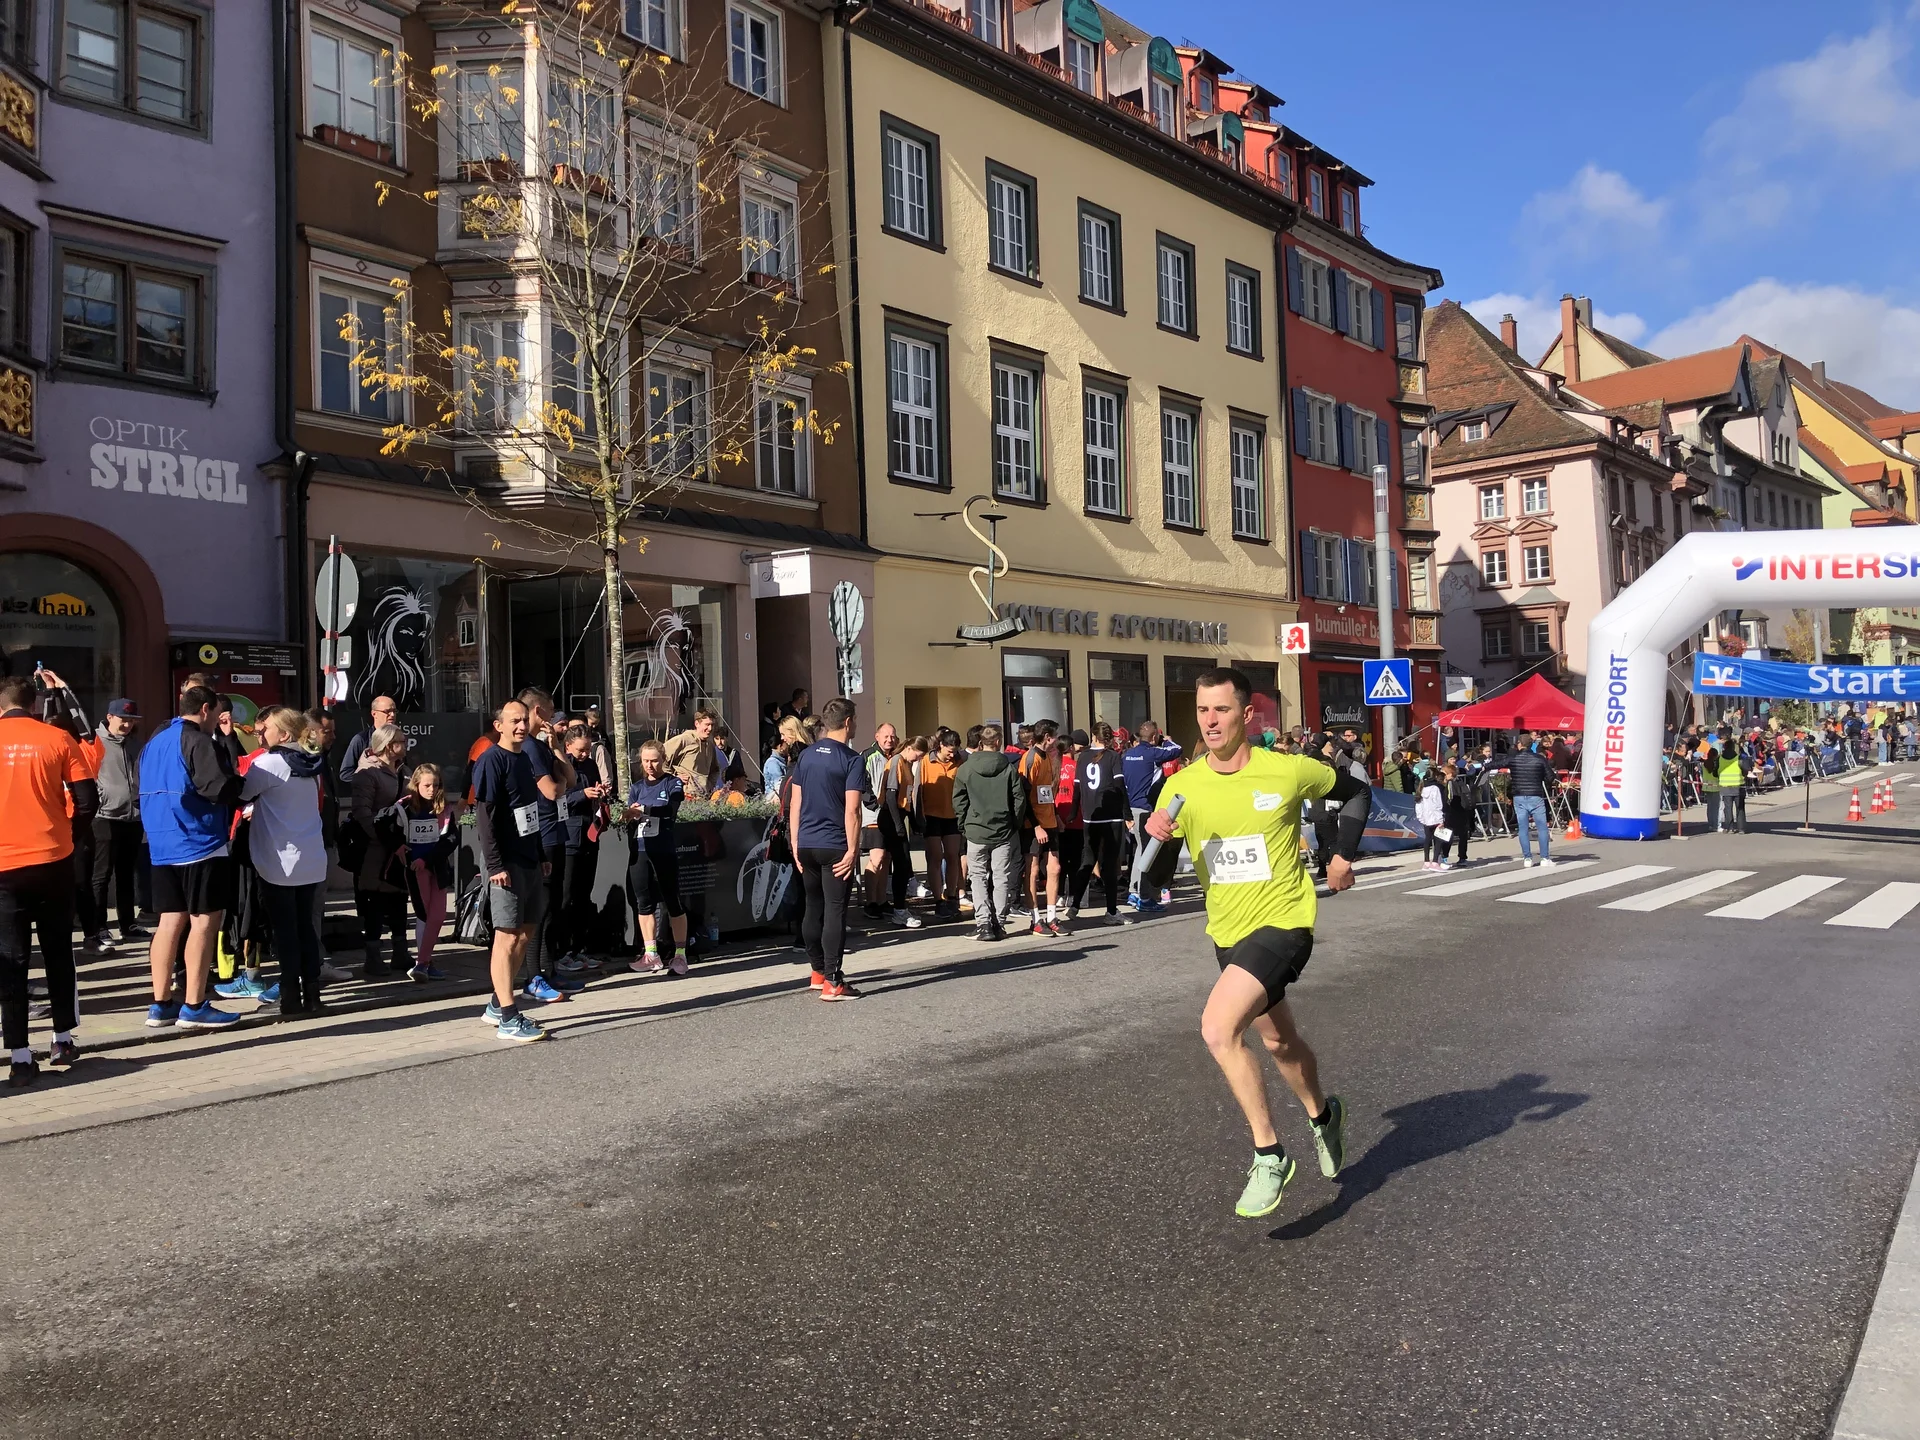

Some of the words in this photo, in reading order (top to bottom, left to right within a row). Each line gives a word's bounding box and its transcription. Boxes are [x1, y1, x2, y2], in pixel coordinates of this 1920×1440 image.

[90, 416, 188, 451] OPTIK
[90, 443, 248, 505] STRIGL
[1111, 613, 1229, 646] APOTHEKE
[1315, 613, 1367, 638] bumüller
[1808, 665, 1907, 695] Start
[398, 721, 434, 736] iseur
[1603, 652, 1629, 789] INTERSPORT
[1086, 761, 1101, 790] 9
[415, 825, 434, 833] 02.2
[1214, 848, 1258, 866] 49.5
